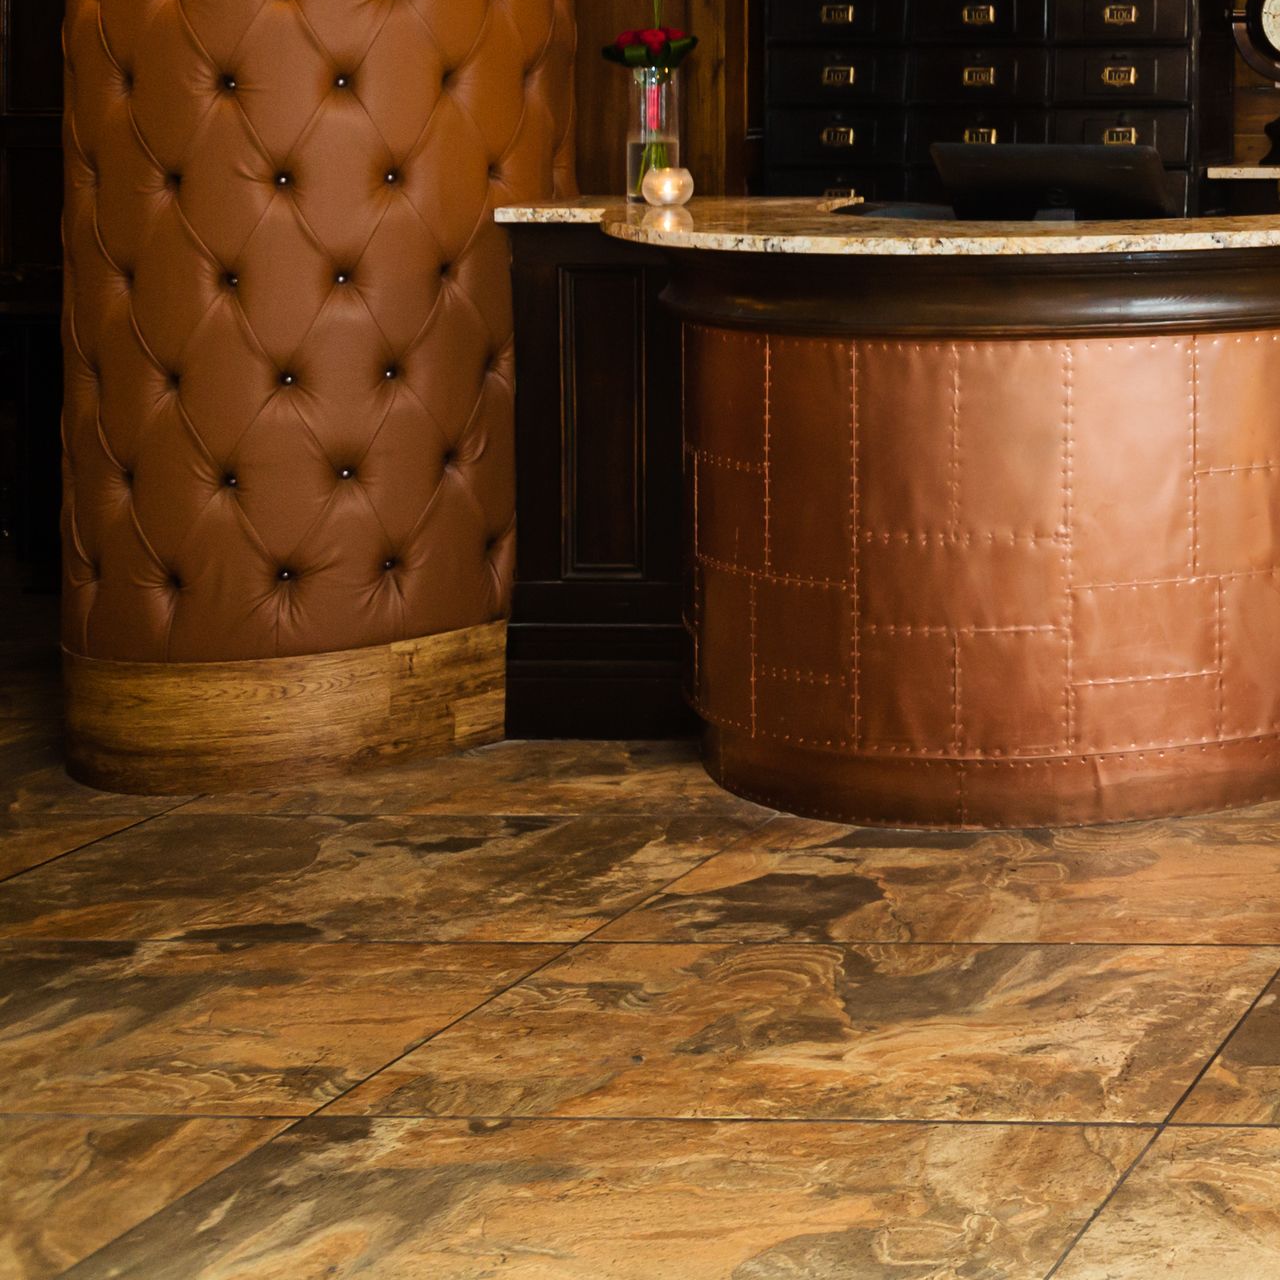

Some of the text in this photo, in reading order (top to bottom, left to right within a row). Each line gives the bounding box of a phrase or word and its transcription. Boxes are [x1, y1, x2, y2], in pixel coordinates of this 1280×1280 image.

[1112, 10, 1131, 20] 106
[830, 71, 847, 81] 107
[1110, 71, 1128, 81] 109
[971, 131, 988, 143] 111
[1112, 131, 1130, 142] 112
